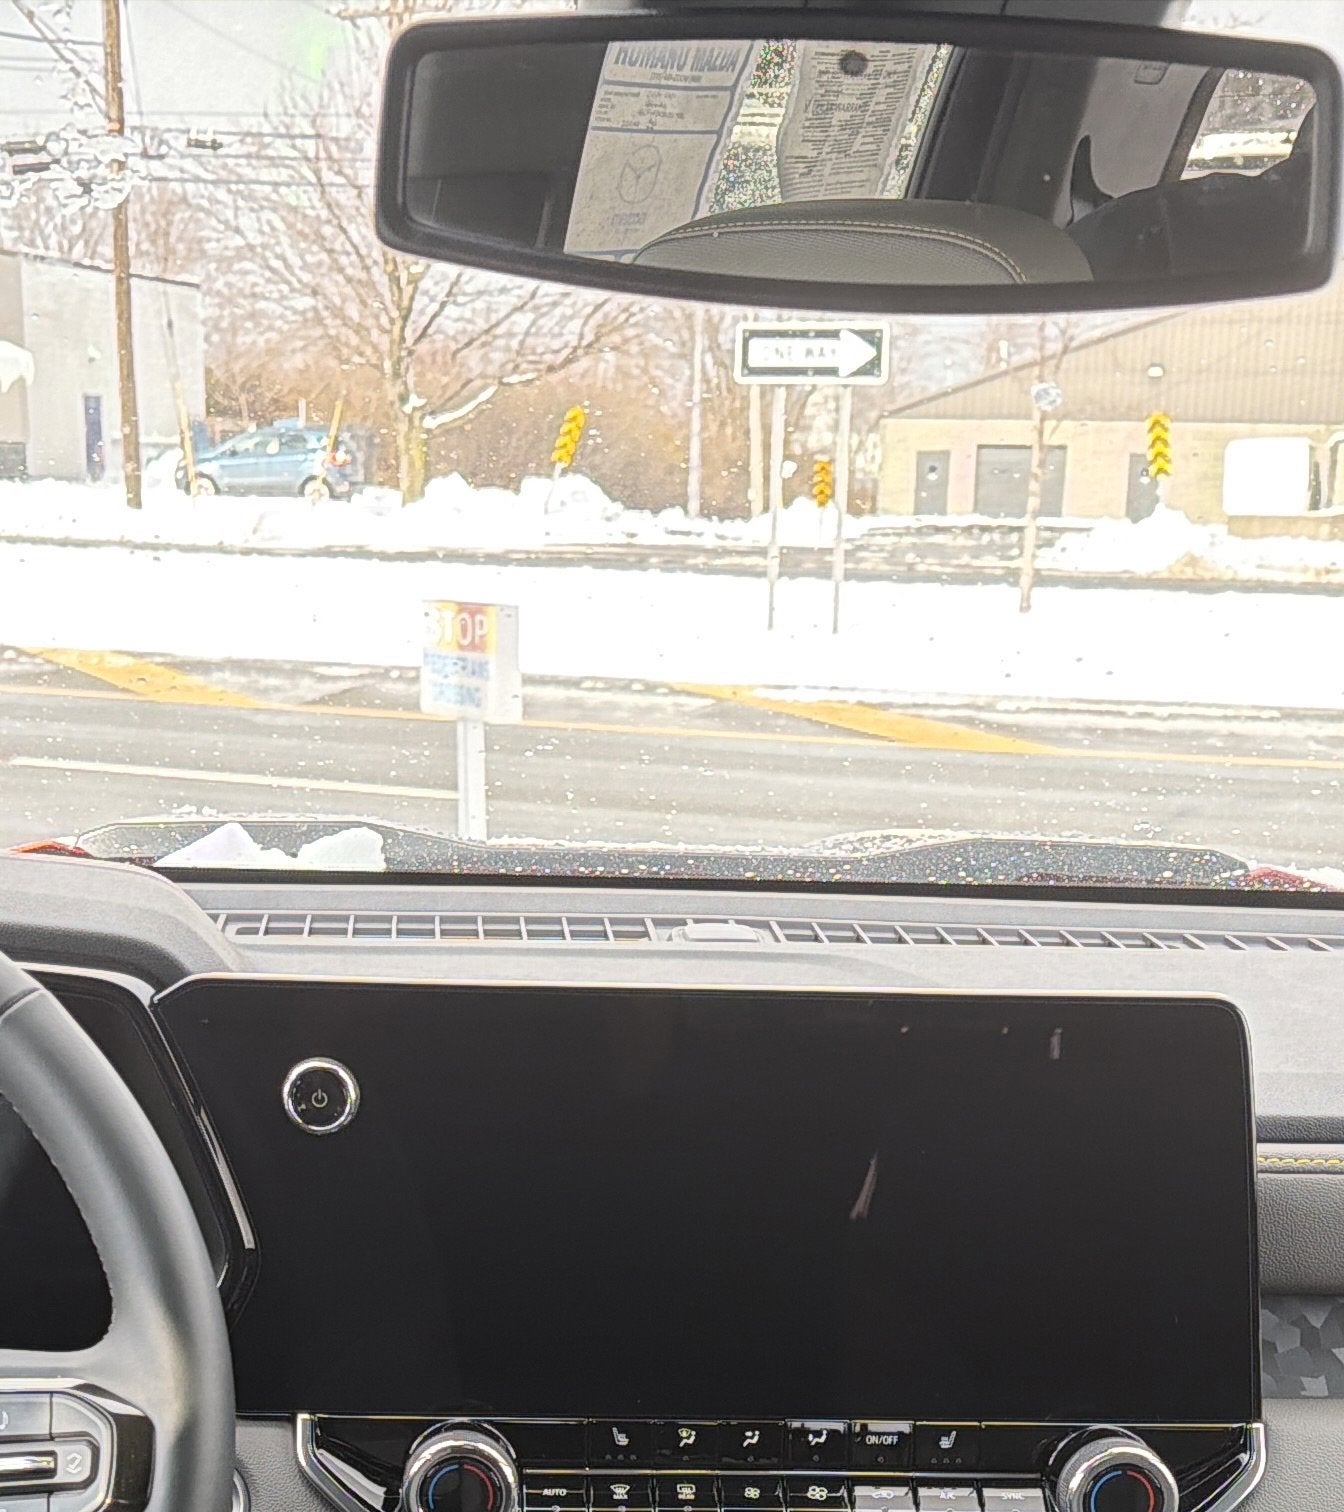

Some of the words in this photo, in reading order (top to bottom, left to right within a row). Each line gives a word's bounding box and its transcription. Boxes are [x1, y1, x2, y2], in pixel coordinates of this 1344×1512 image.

[690, 48, 742, 73] MAZDA
[865, 1435, 899, 1445] ON/OFF
[542, 1488, 567, 1497] AUTO
[1001, 1492, 1025, 1501] SYNC
